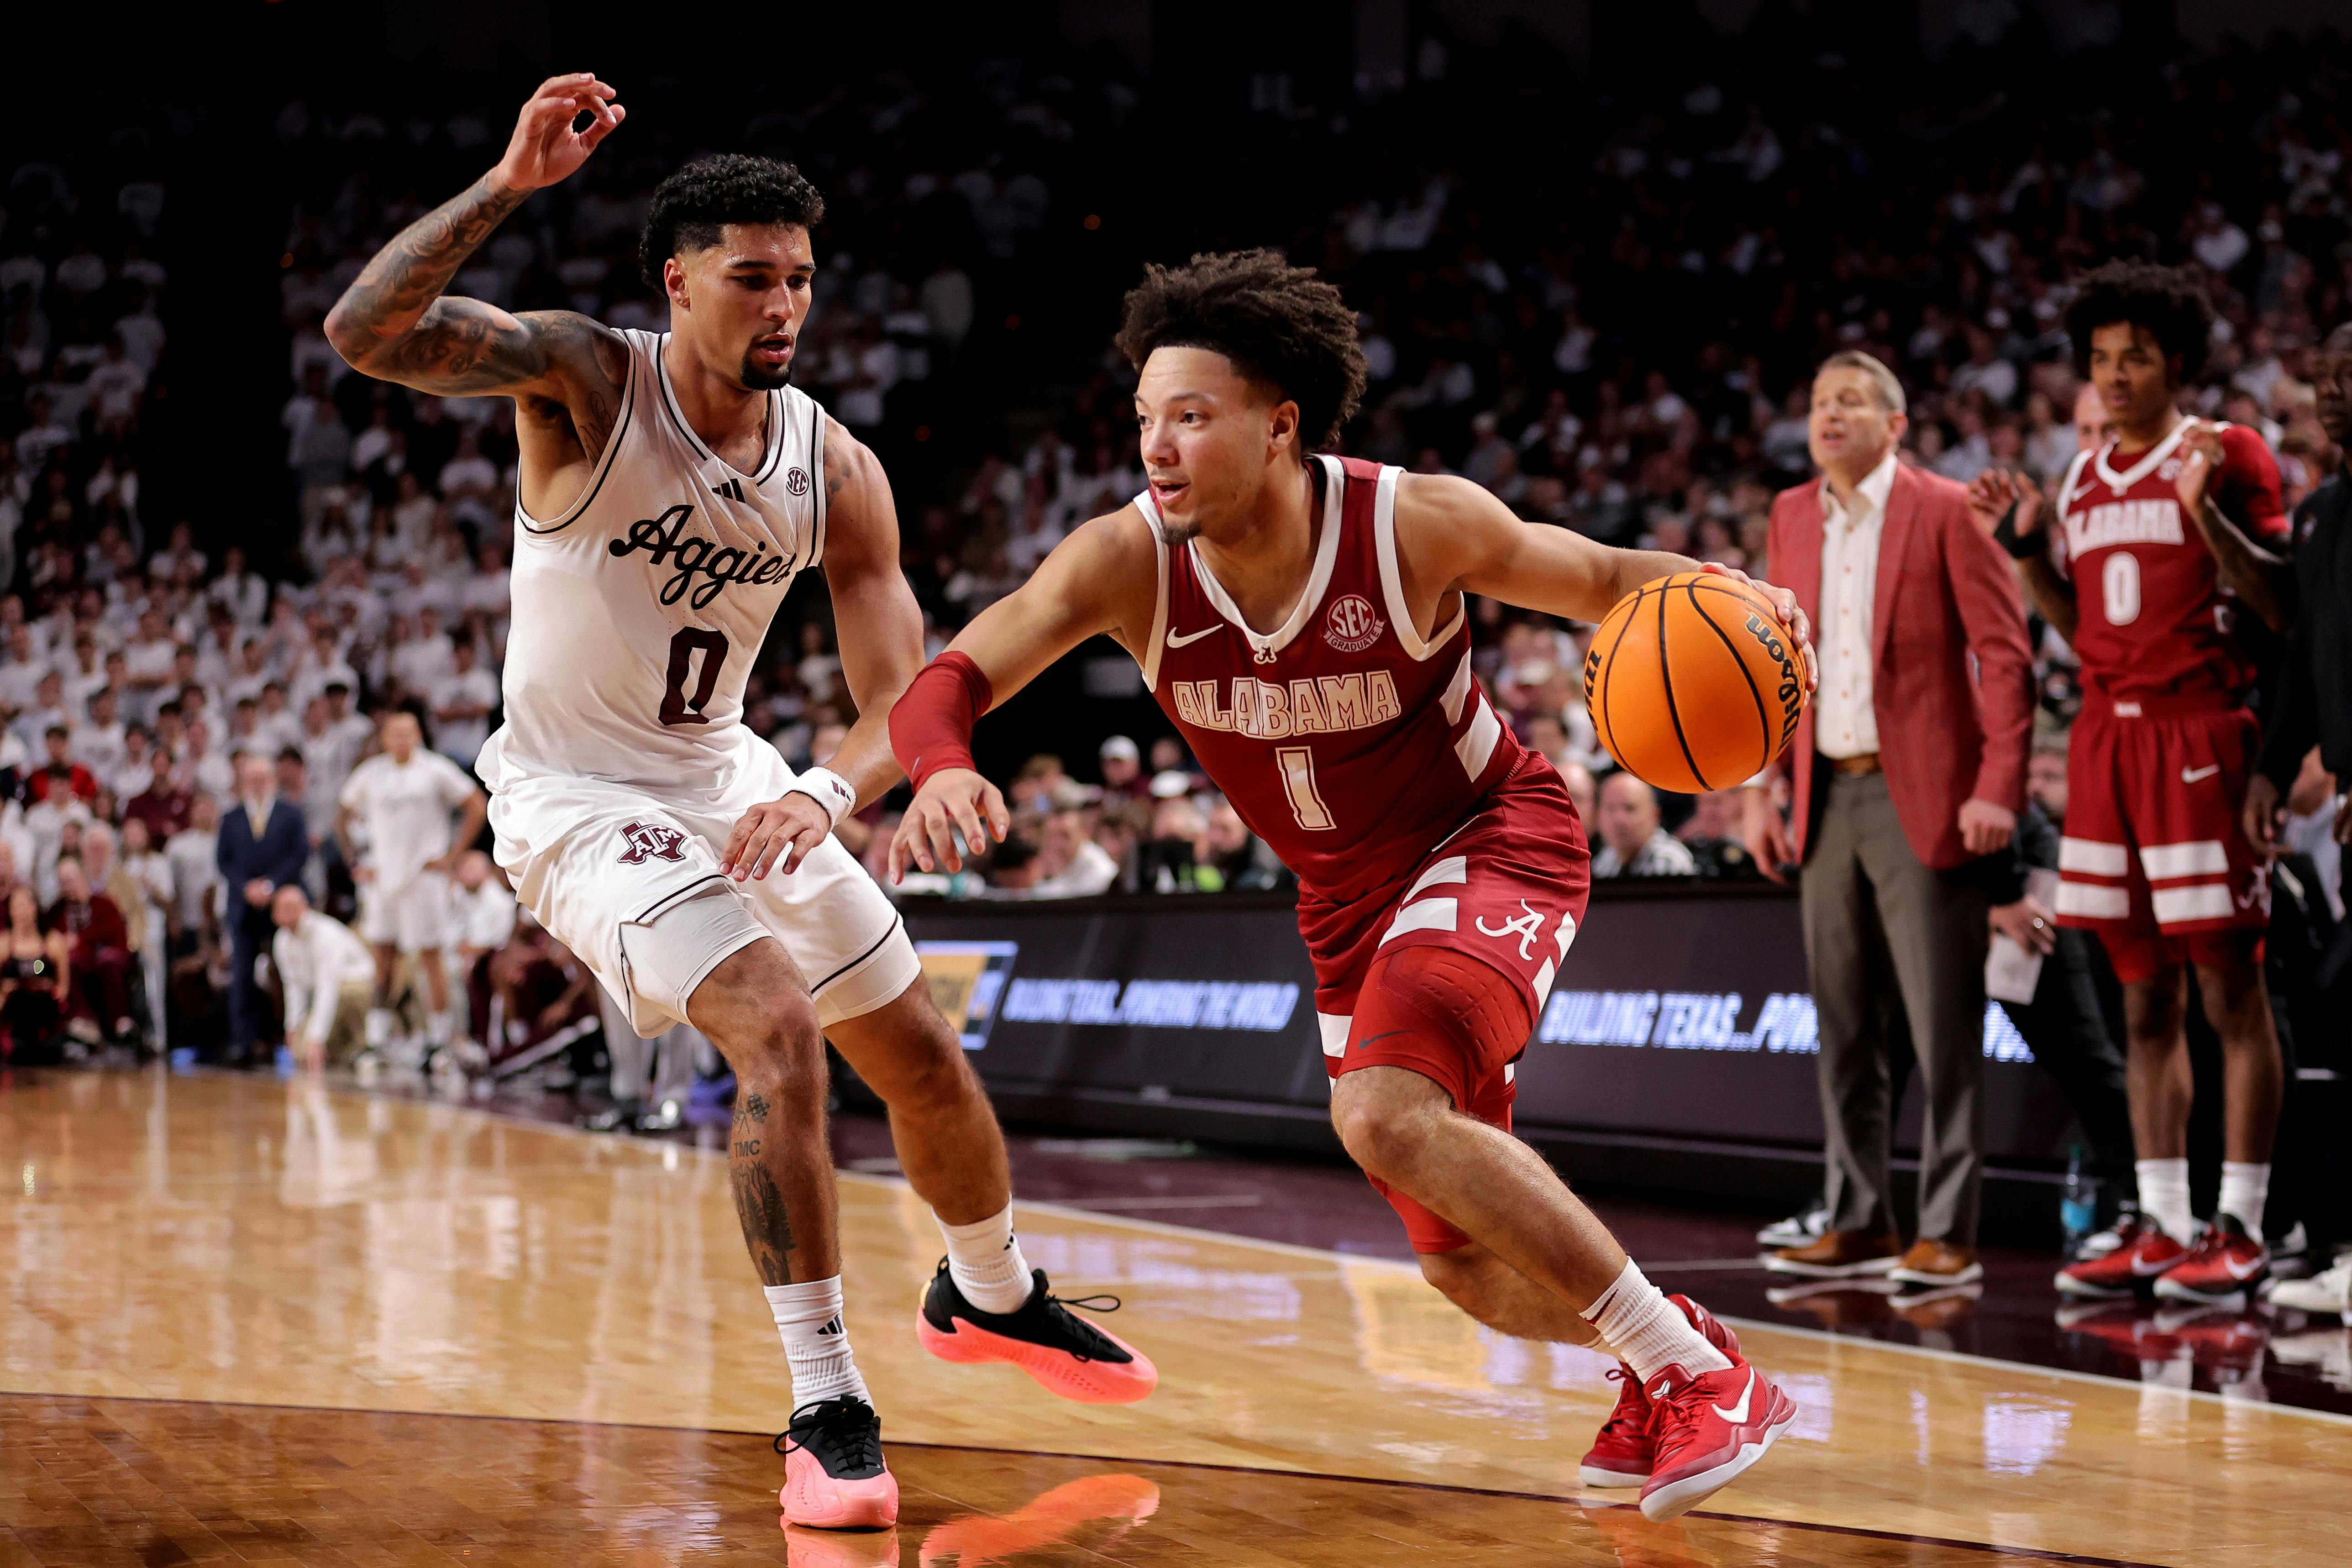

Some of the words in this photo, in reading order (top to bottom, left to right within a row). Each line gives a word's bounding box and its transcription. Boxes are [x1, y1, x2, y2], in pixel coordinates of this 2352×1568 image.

[787, 469, 807, 493] SEC
[609, 504, 797, 610] Aggies
[2102, 551, 2141, 626] 0
[1331, 598, 1370, 638] SEC
[1331, 629, 1379, 651] GRADUATE
[657, 626, 730, 726] 0
[1173, 670, 1401, 739] ALABAMA
[1745, 610, 1801, 753] Wilson
[1275, 746, 1337, 831] 1
[1475, 898, 1546, 961] A
[734, 1140, 761, 1158] TMC
